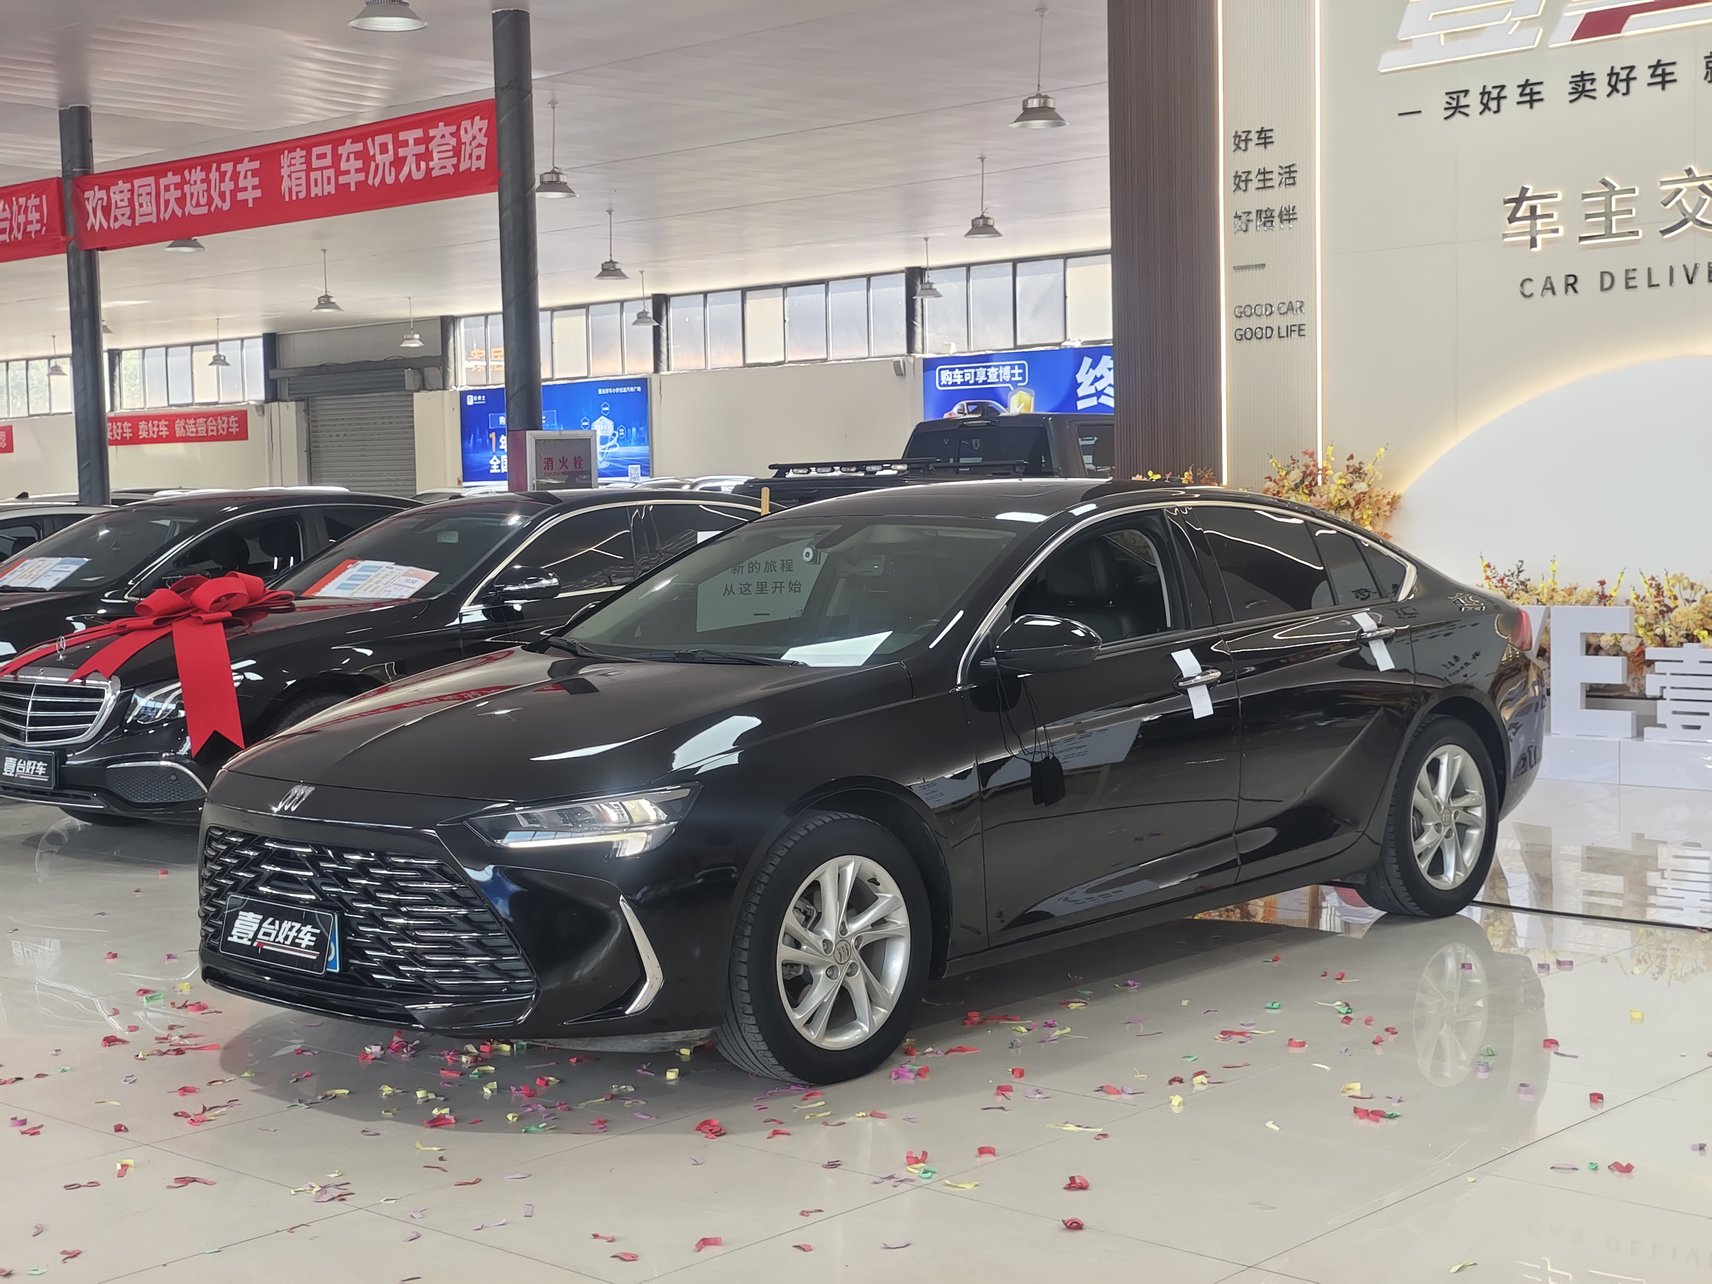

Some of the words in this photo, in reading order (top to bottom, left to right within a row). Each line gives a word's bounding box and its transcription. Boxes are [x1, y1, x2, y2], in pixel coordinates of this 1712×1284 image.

[1443, 78, 1545, 121] 买好车
[1568, 58, 1678, 104] 卖好车
[1232, 127, 1275, 153] 好车
[85, 157, 262, 233] 欢度国庆选好车
[280, 115, 488, 202] 精品车况无套路
[1232, 164, 1298, 193] 好生活
[1232, 205, 1298, 233] 好陪伴
[1502, 166, 1712, 252] 车主交
[1519, 273, 1579, 299] CAR
[1233, 303, 1274, 319] GOOD
[1277, 300, 1306, 316] CAR
[1233, 325, 1274, 341] GOOD
[1277, 323, 1306, 339] LIFE
[940, 365, 1024, 385] 购车可享查博士
[138, 419, 169, 440] 卖好车
[175, 416, 239, 438] 就选壹台好车
[543, 456, 584, 472] 消火栓
[731, 559, 794, 575] 新的旅程
[722, 581, 802, 597] 从这里开始
[2, 756, 48, 777] 壹台好车
[227, 911, 321, 949] 壹台好车
